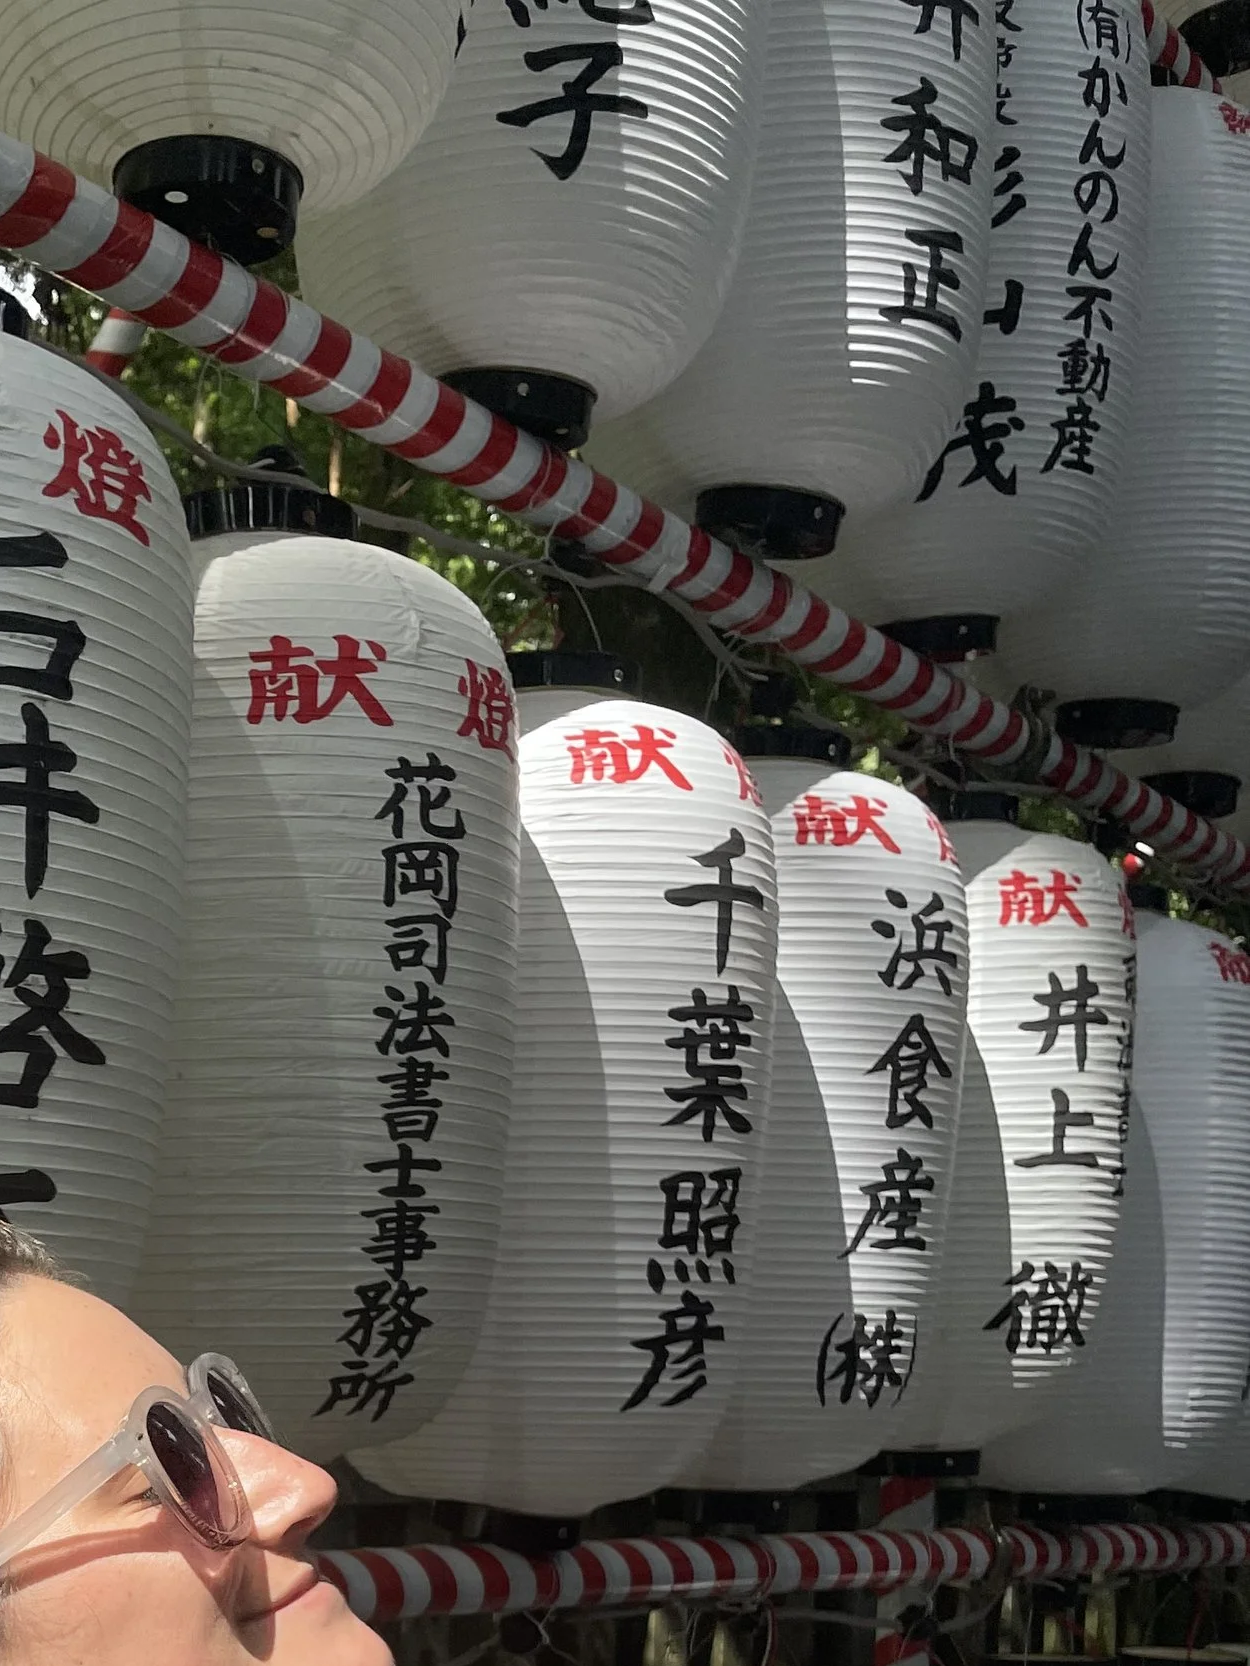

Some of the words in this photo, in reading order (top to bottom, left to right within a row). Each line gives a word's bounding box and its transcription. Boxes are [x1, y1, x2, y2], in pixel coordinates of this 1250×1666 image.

[496, 0, 655, 181] 子
[1039, 0, 1132, 476] (有)かんのん不動産
[42, 409, 152, 547] 燈
[246, 634, 394, 726] 献
[565, 725, 693, 791] 献
[793, 794, 901, 854] 献
[998, 869, 1089, 928] 献
[312, 752, 467, 1423] 花岡司法書士事務所
[620, 827, 764, 1413] 千葉照彦
[816, 889, 958, 1408] 浜食産(株)
[982, 964, 1109, 1354] 井上徹
